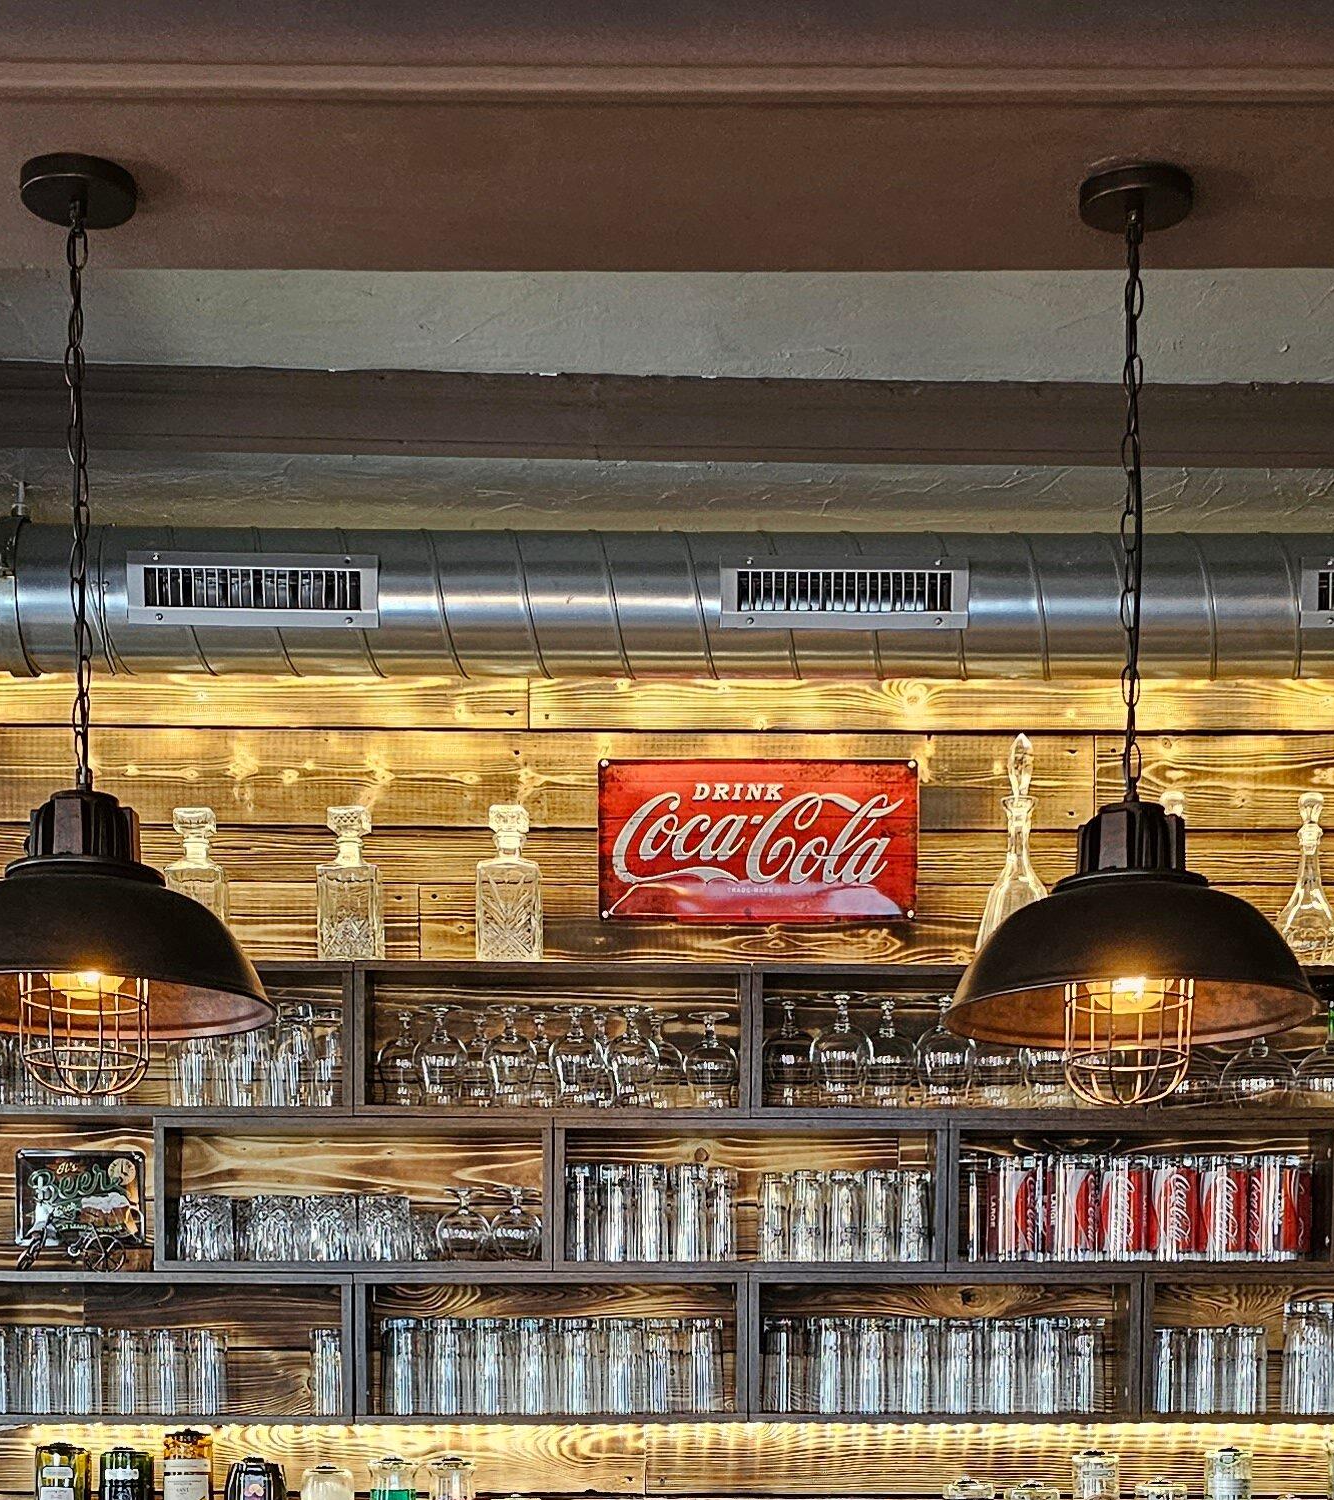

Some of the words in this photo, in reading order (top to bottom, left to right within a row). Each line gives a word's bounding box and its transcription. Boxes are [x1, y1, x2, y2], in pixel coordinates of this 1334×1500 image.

[692, 783, 785, 802] DRINK
[612, 792, 904, 885] Coca-Cola
[28, 1163, 120, 1200] Beer
[57, 1161, 78, 1175] It's
